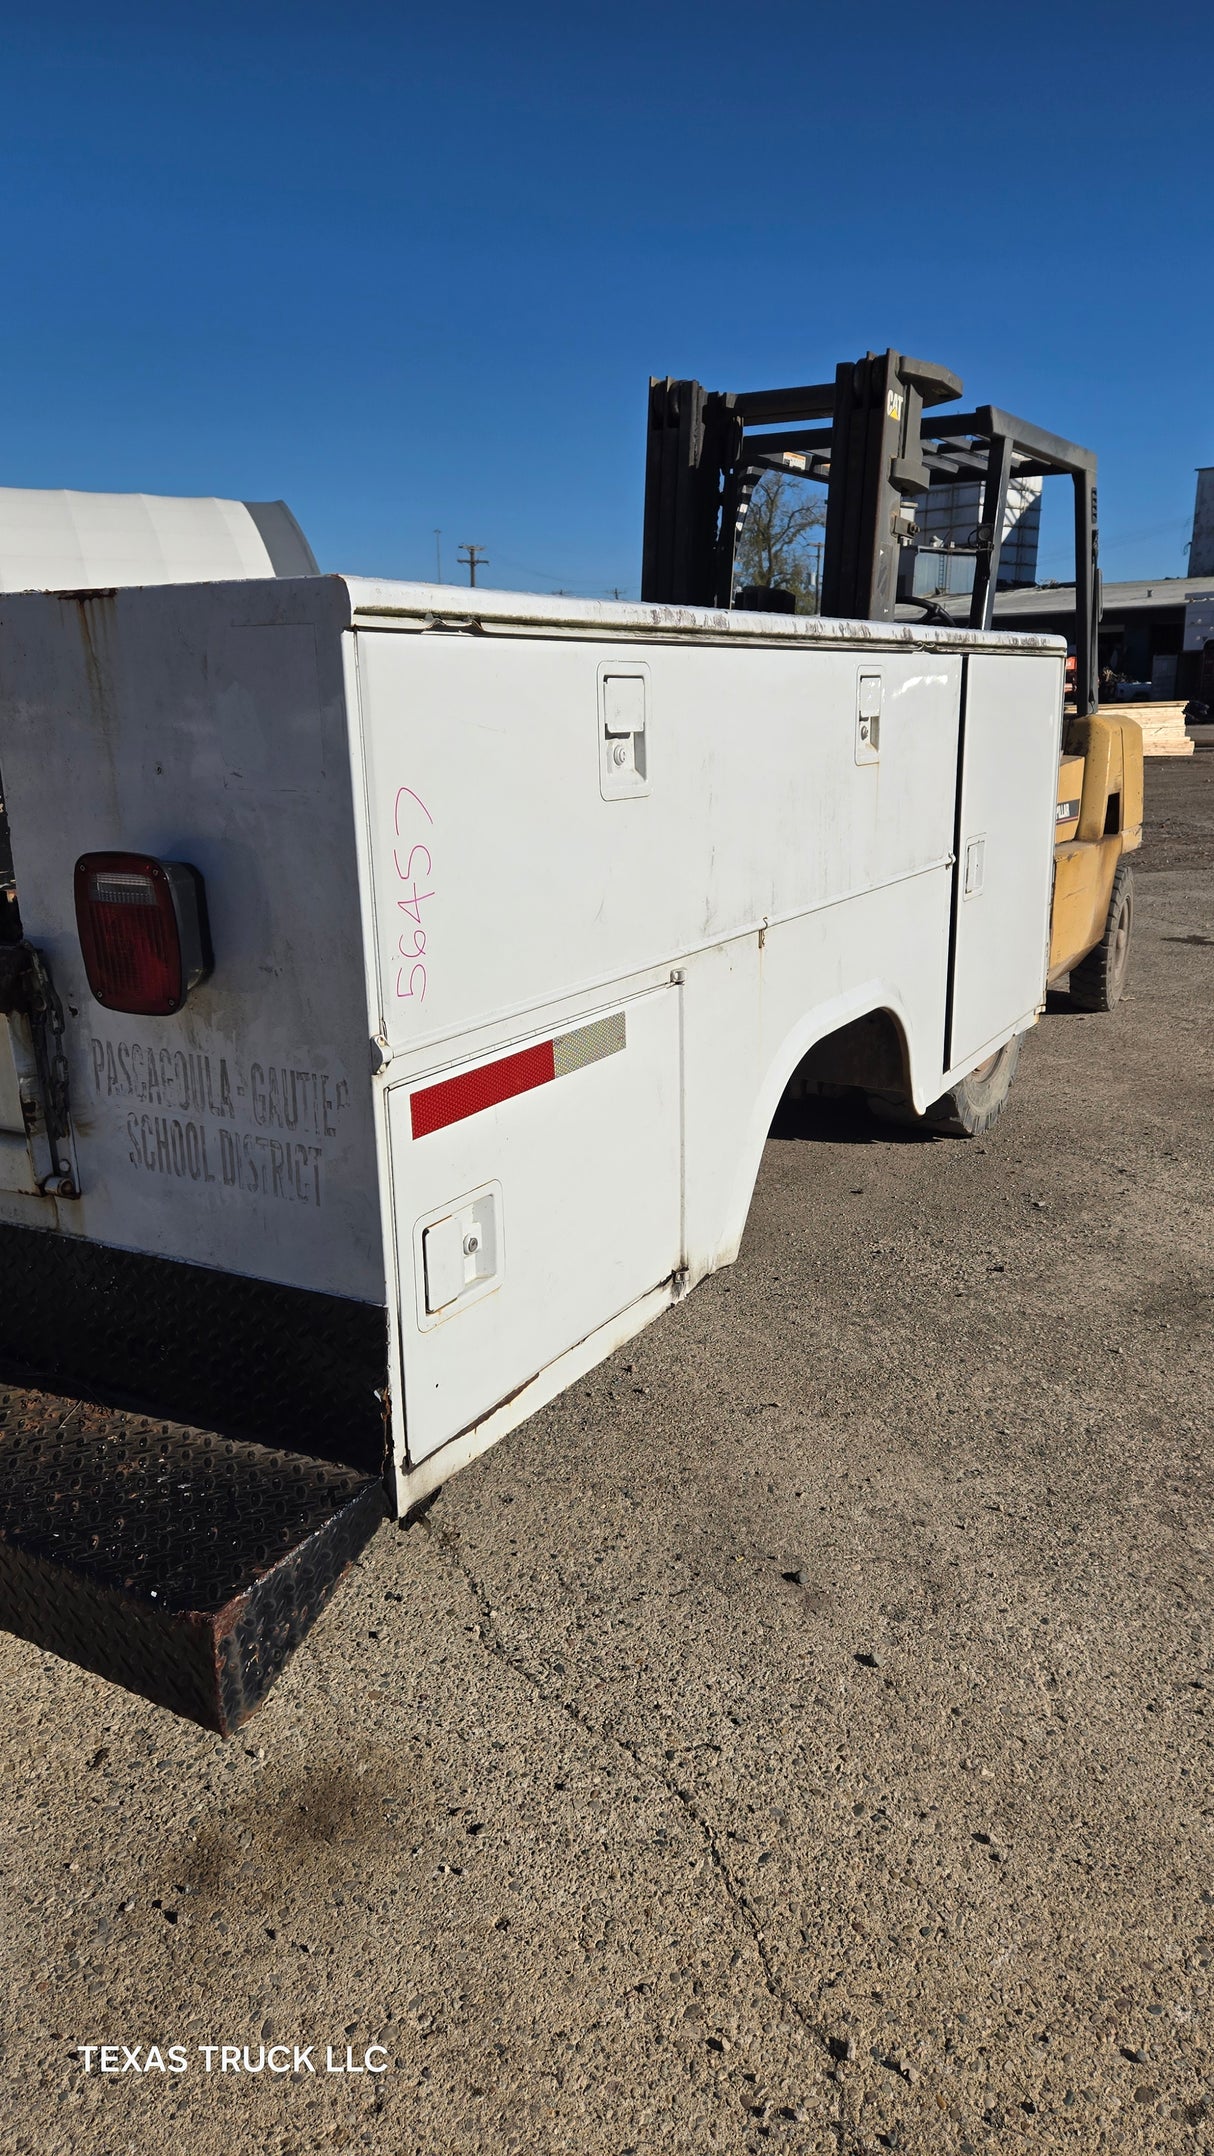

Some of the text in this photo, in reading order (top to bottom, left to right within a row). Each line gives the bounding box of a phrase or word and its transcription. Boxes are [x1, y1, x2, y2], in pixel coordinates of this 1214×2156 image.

[887, 389, 903, 421] CAT
[393, 786, 435, 1003] 56457
[127, 1111, 322, 1207] SCHOOL DISTRICT
